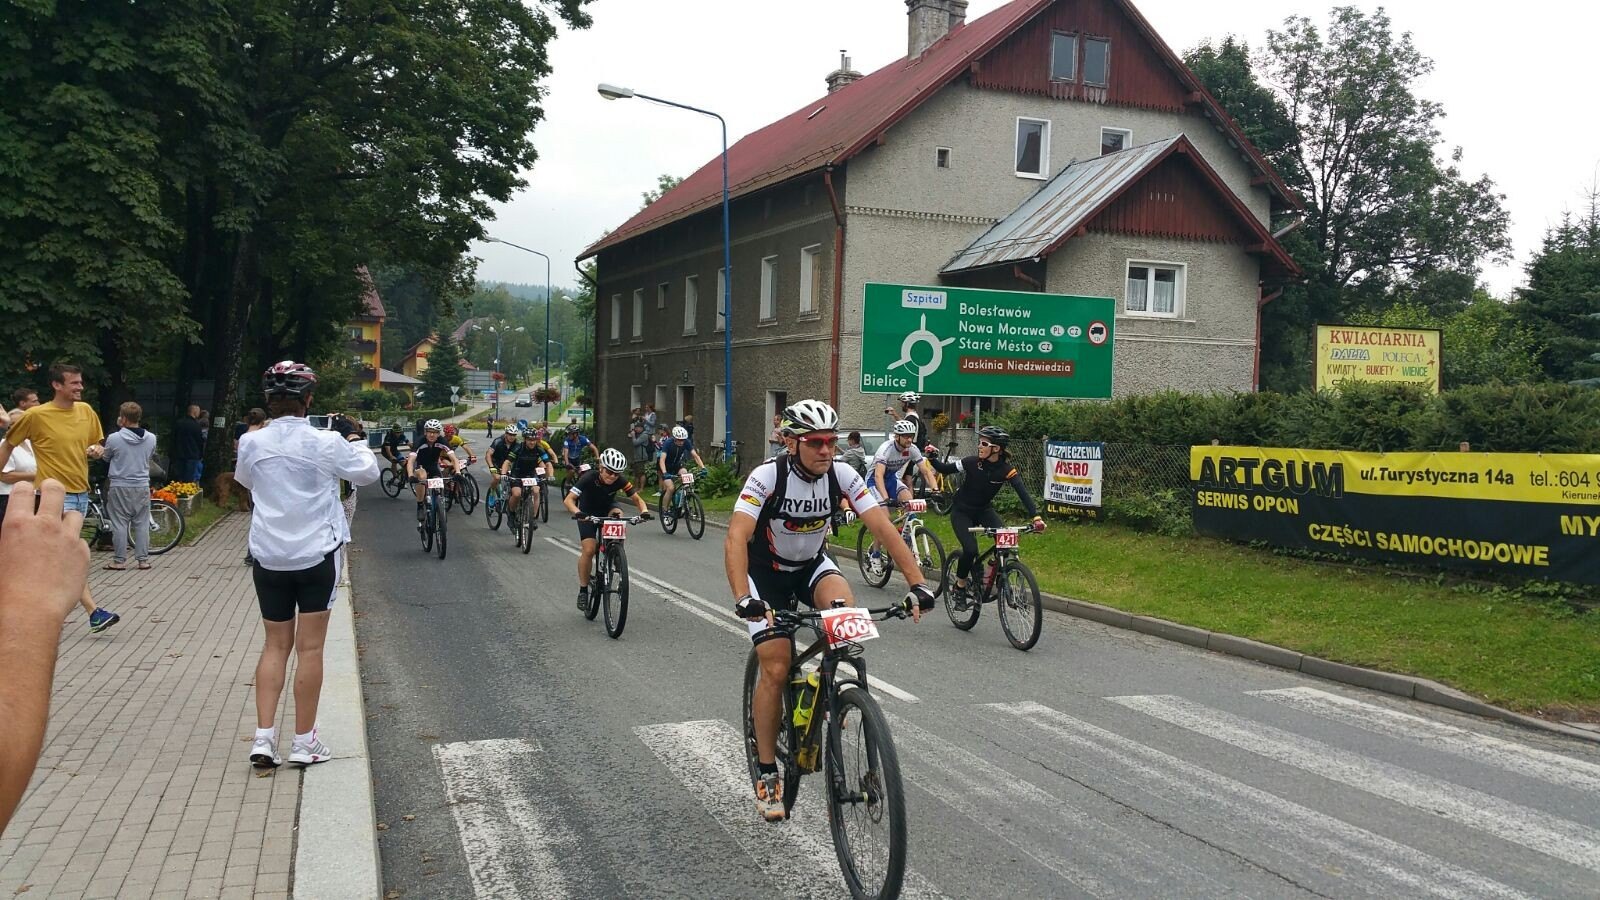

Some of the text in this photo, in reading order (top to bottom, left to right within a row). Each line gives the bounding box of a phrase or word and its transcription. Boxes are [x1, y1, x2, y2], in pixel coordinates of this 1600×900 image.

[907, 293, 942, 305] Szpital
[959, 303, 1032, 318] Bolesławów
[959, 320, 993, 334] Nowa
[998, 322, 1046, 336] Morawa
[958, 337, 992, 351] Staré
[1330, 330, 1426, 347] KWIACIARNIA
[962, 358, 1003, 370] Jaskinia
[1327, 364, 1357, 375] KWIATY
[1366, 365, 1395, 376] BUKIETY
[863, 373, 907, 387] Bielice
[1198, 456, 1345, 499] ARTGUM
[1485, 469, 1514, 485] 14a
[783, 498, 828, 512] RYBIK
[1197, 491, 1299, 514] SERWIS OPON
[605, 525, 623, 536] 421
[998, 533, 1015, 545] 421
[1308, 523, 1550, 566] CZĘŚCI SAMOCHODOWE
